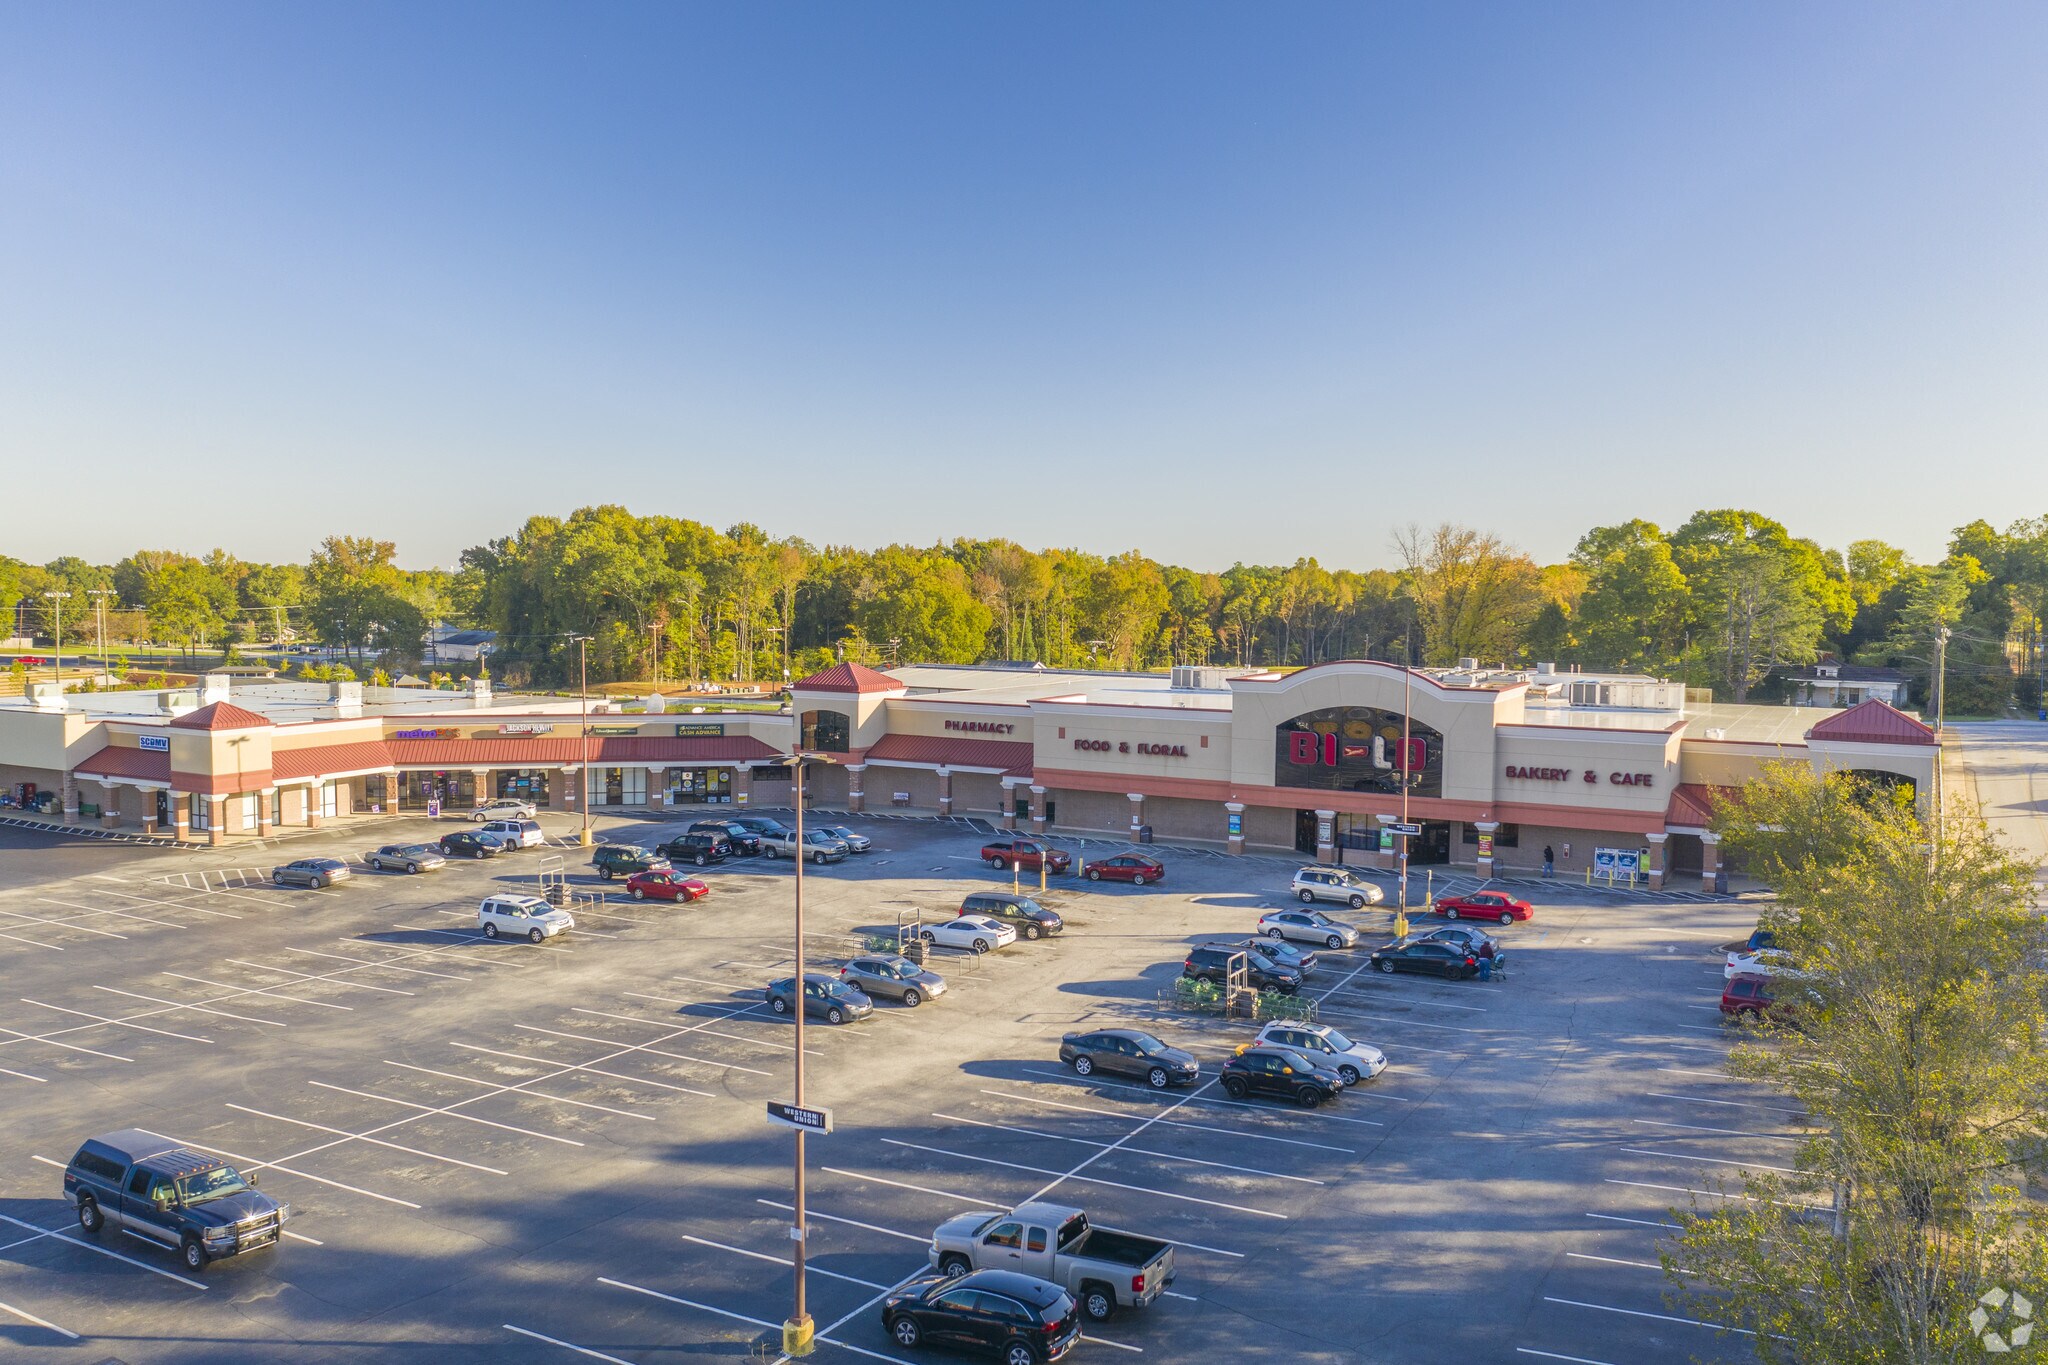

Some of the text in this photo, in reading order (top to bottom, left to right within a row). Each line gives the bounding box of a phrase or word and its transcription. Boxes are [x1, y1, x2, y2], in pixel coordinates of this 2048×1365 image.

[944, 720, 1013, 734] PHARMACY
[140, 737, 167, 747] SCDMV
[1074, 739, 1188, 757] FOOD & FLORAL
[1289, 730, 1427, 771] BI-LO
[1505, 765, 1653, 787] BAKERY & CAFE
[784, 1107, 817, 1119] WESTERN
[794, 1115, 817, 1125] UNION
